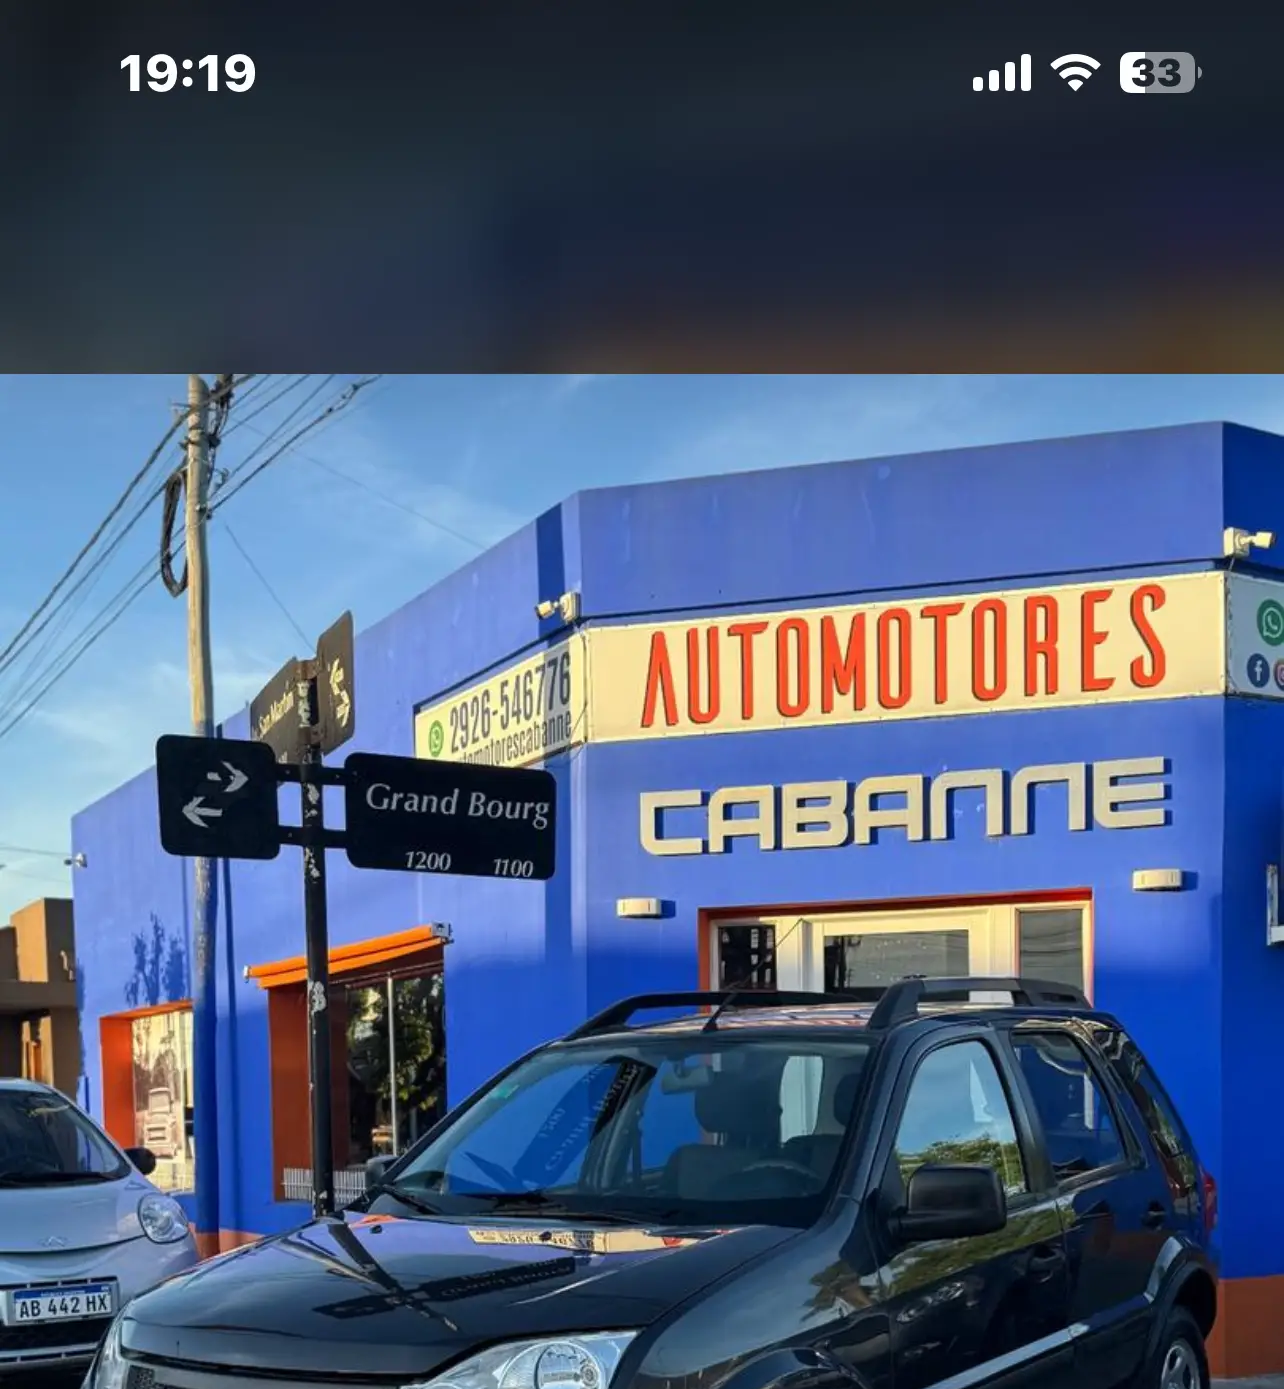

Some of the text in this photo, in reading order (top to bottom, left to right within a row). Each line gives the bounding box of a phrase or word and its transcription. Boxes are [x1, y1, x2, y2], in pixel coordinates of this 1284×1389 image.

[641, 583, 1167, 728] AUTOMOTORES
[450, 651, 571, 753] 2926-546776
[366, 783, 550, 830] Grand Bourg
[640, 757, 1171, 855] CABANNE
[405, 851, 534, 878] 1200 1100
[20, 1294, 107, 1318] AB 442 HX
